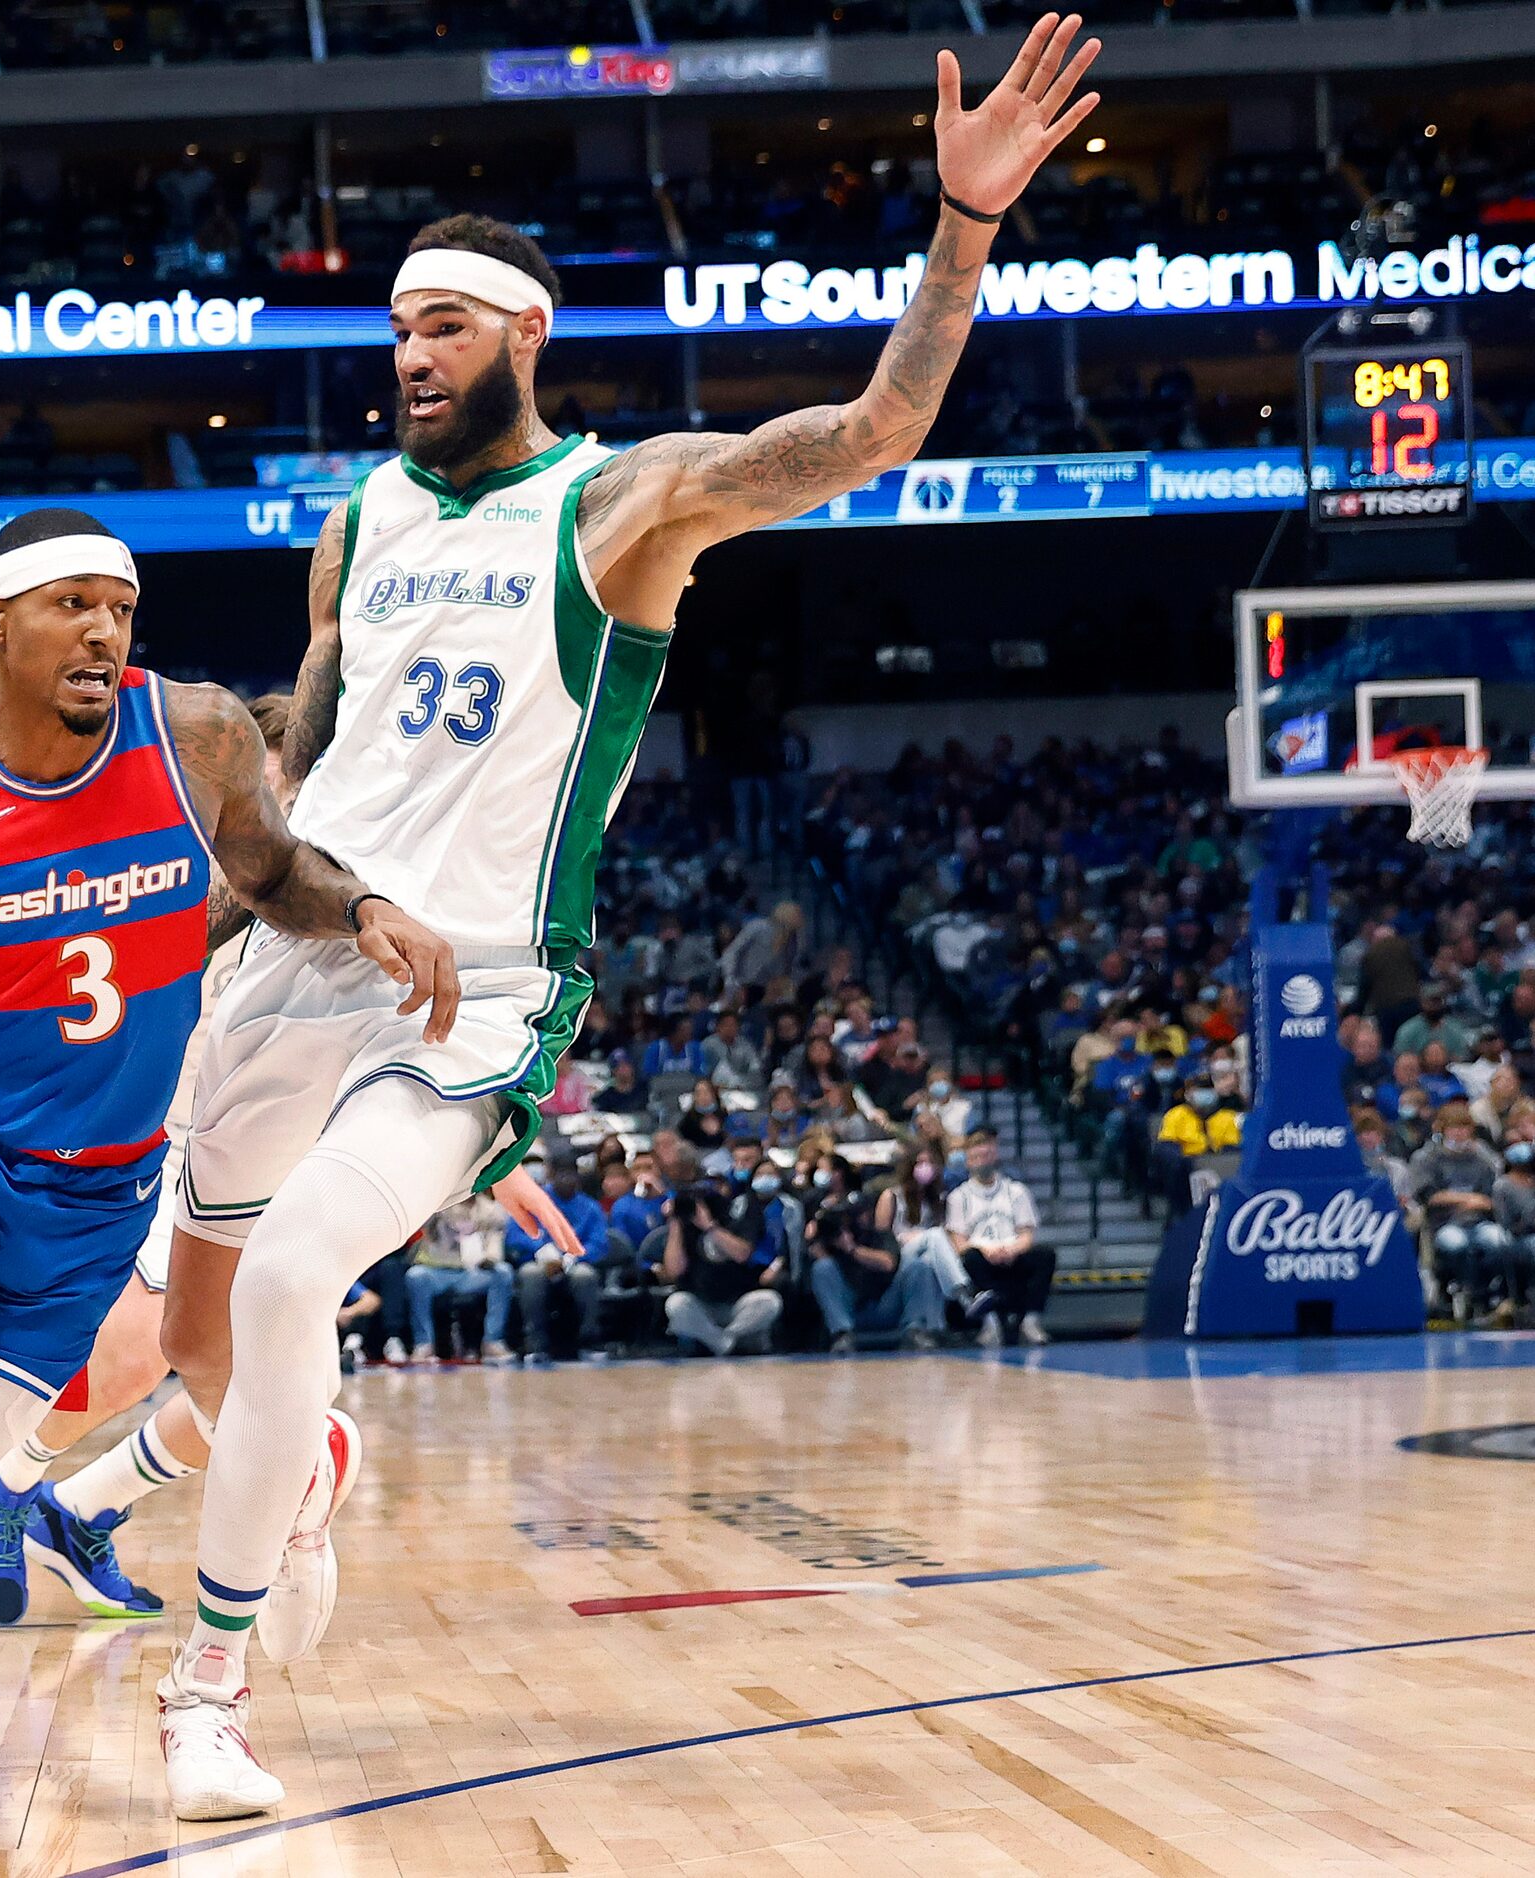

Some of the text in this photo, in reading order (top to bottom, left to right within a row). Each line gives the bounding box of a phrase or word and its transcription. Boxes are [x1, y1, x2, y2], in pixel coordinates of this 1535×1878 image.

[44, 288, 264, 351] Center
[1354, 358, 1449, 407] 8:47
[1371, 404, 1439, 479] 12
[482, 501, 542, 523] chime
[1084, 483, 1104, 509] 7
[1361, 486, 1464, 516] TISSOT
[356, 565, 535, 621] DALLAS
[396, 656, 505, 748] 33
[56, 932, 127, 1046] 3
[1279, 1015, 1327, 1038] AT&T
[1268, 1121, 1347, 1150] chime
[1226, 1188, 1399, 1267] Bally
[1265, 1251, 1360, 1282] SPORTS
